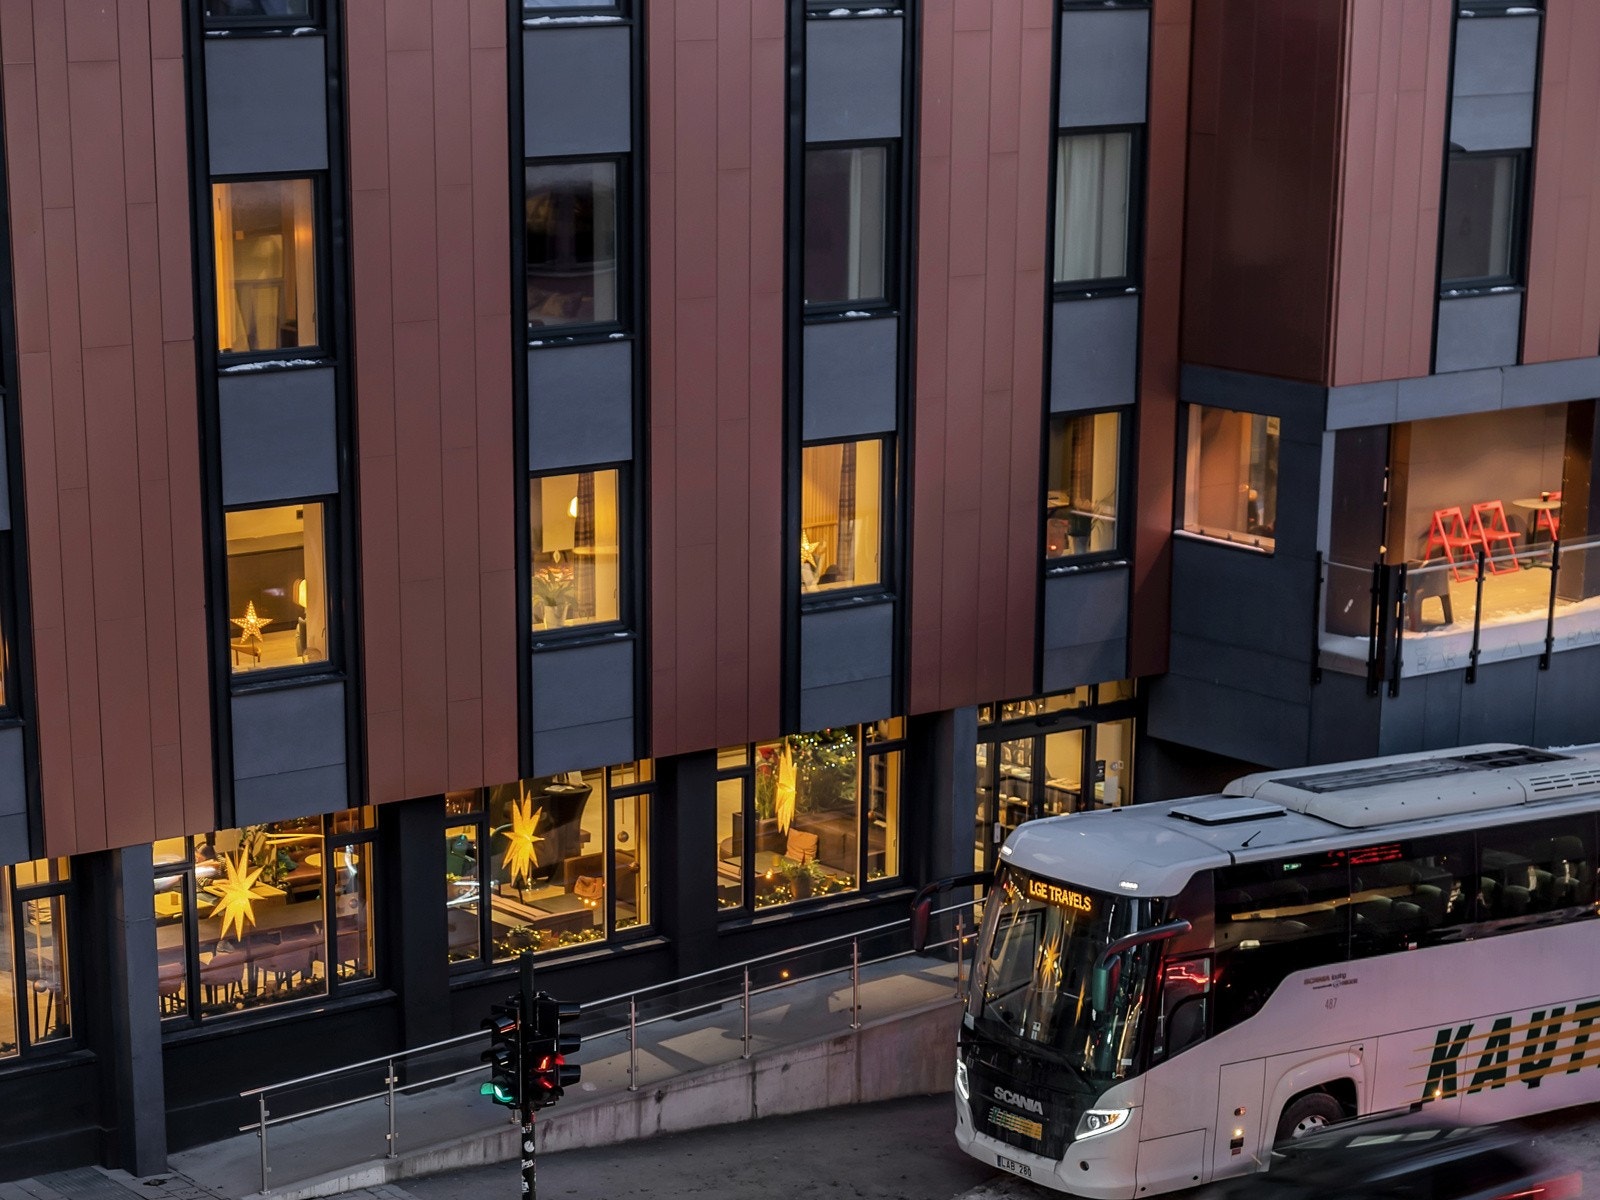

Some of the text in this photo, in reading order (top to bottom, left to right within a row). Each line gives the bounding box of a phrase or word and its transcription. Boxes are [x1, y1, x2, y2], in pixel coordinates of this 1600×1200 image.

[1029, 879, 1092, 912] LGE TRAVELS
[1324, 997, 1338, 1010] 487
[1420, 1000, 1600, 1104] KAUT
[993, 1086, 1044, 1116] SCANIA
[1002, 1158, 1016, 1171] LAB
